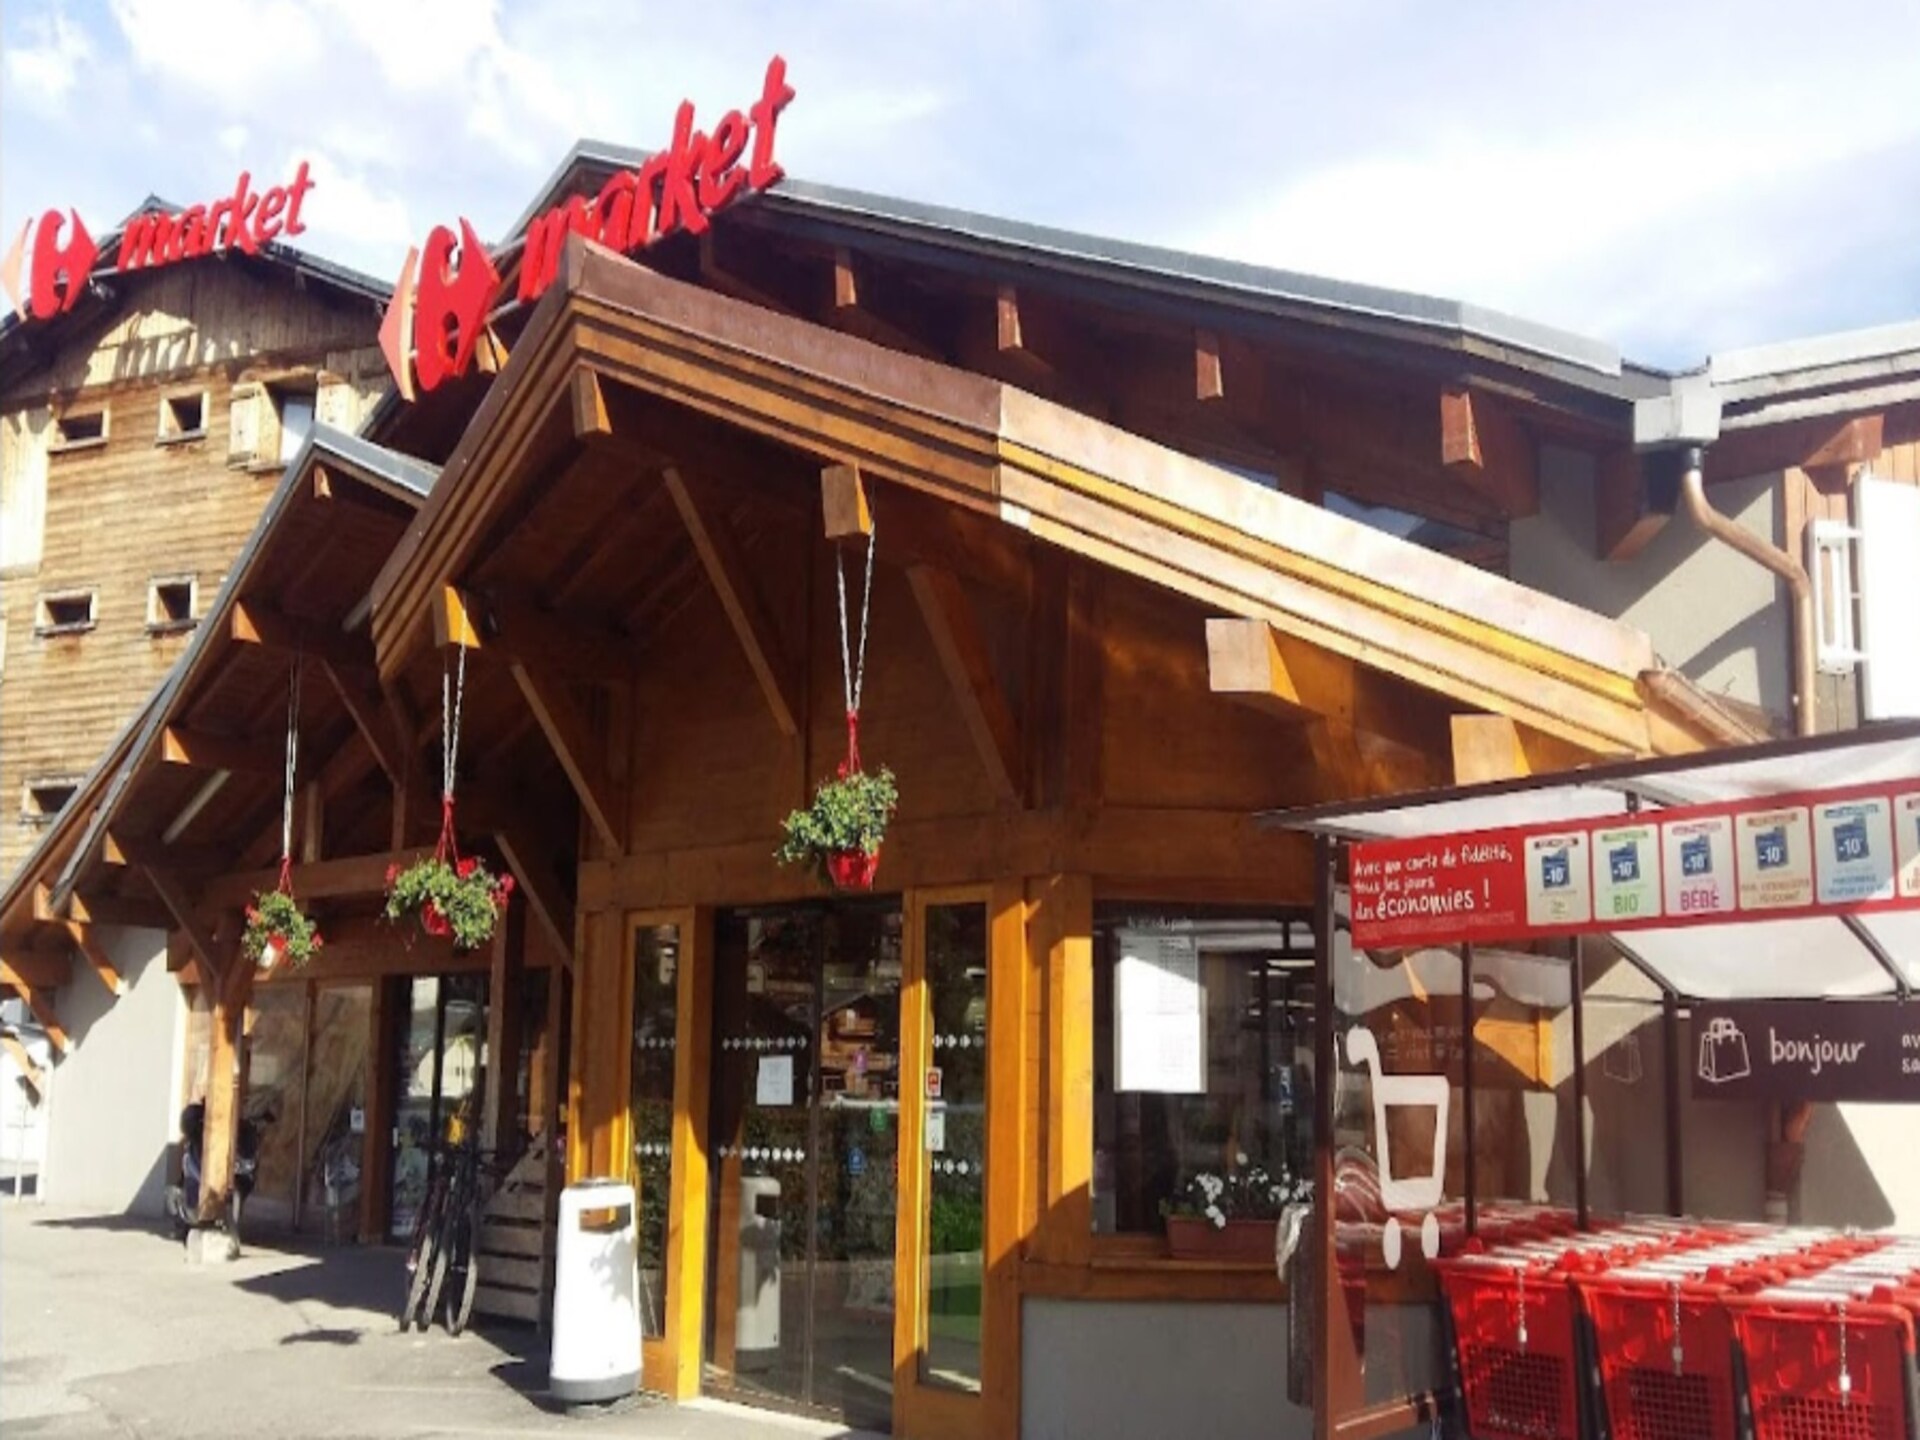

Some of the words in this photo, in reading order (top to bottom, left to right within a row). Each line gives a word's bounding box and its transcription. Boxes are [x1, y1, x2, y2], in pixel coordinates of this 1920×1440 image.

[518, 54, 796, 305] market
[117, 161, 316, 272] market
[1354, 859, 1382, 877] Avec
[1406, 853, 1438, 871] carte
[1442, 848, 1457, 868] de
[1354, 880, 1380, 895] tous
[1384, 876, 1400, 892] les
[1404, 875, 1436, 896] jours
[1680, 886, 1721, 912] BÉBÉ
[1356, 901, 1375, 921] des
[1376, 887, 1475, 920] économies
[1613, 892, 1640, 914] BIO
[1769, 1026, 1866, 1075] bonjour
